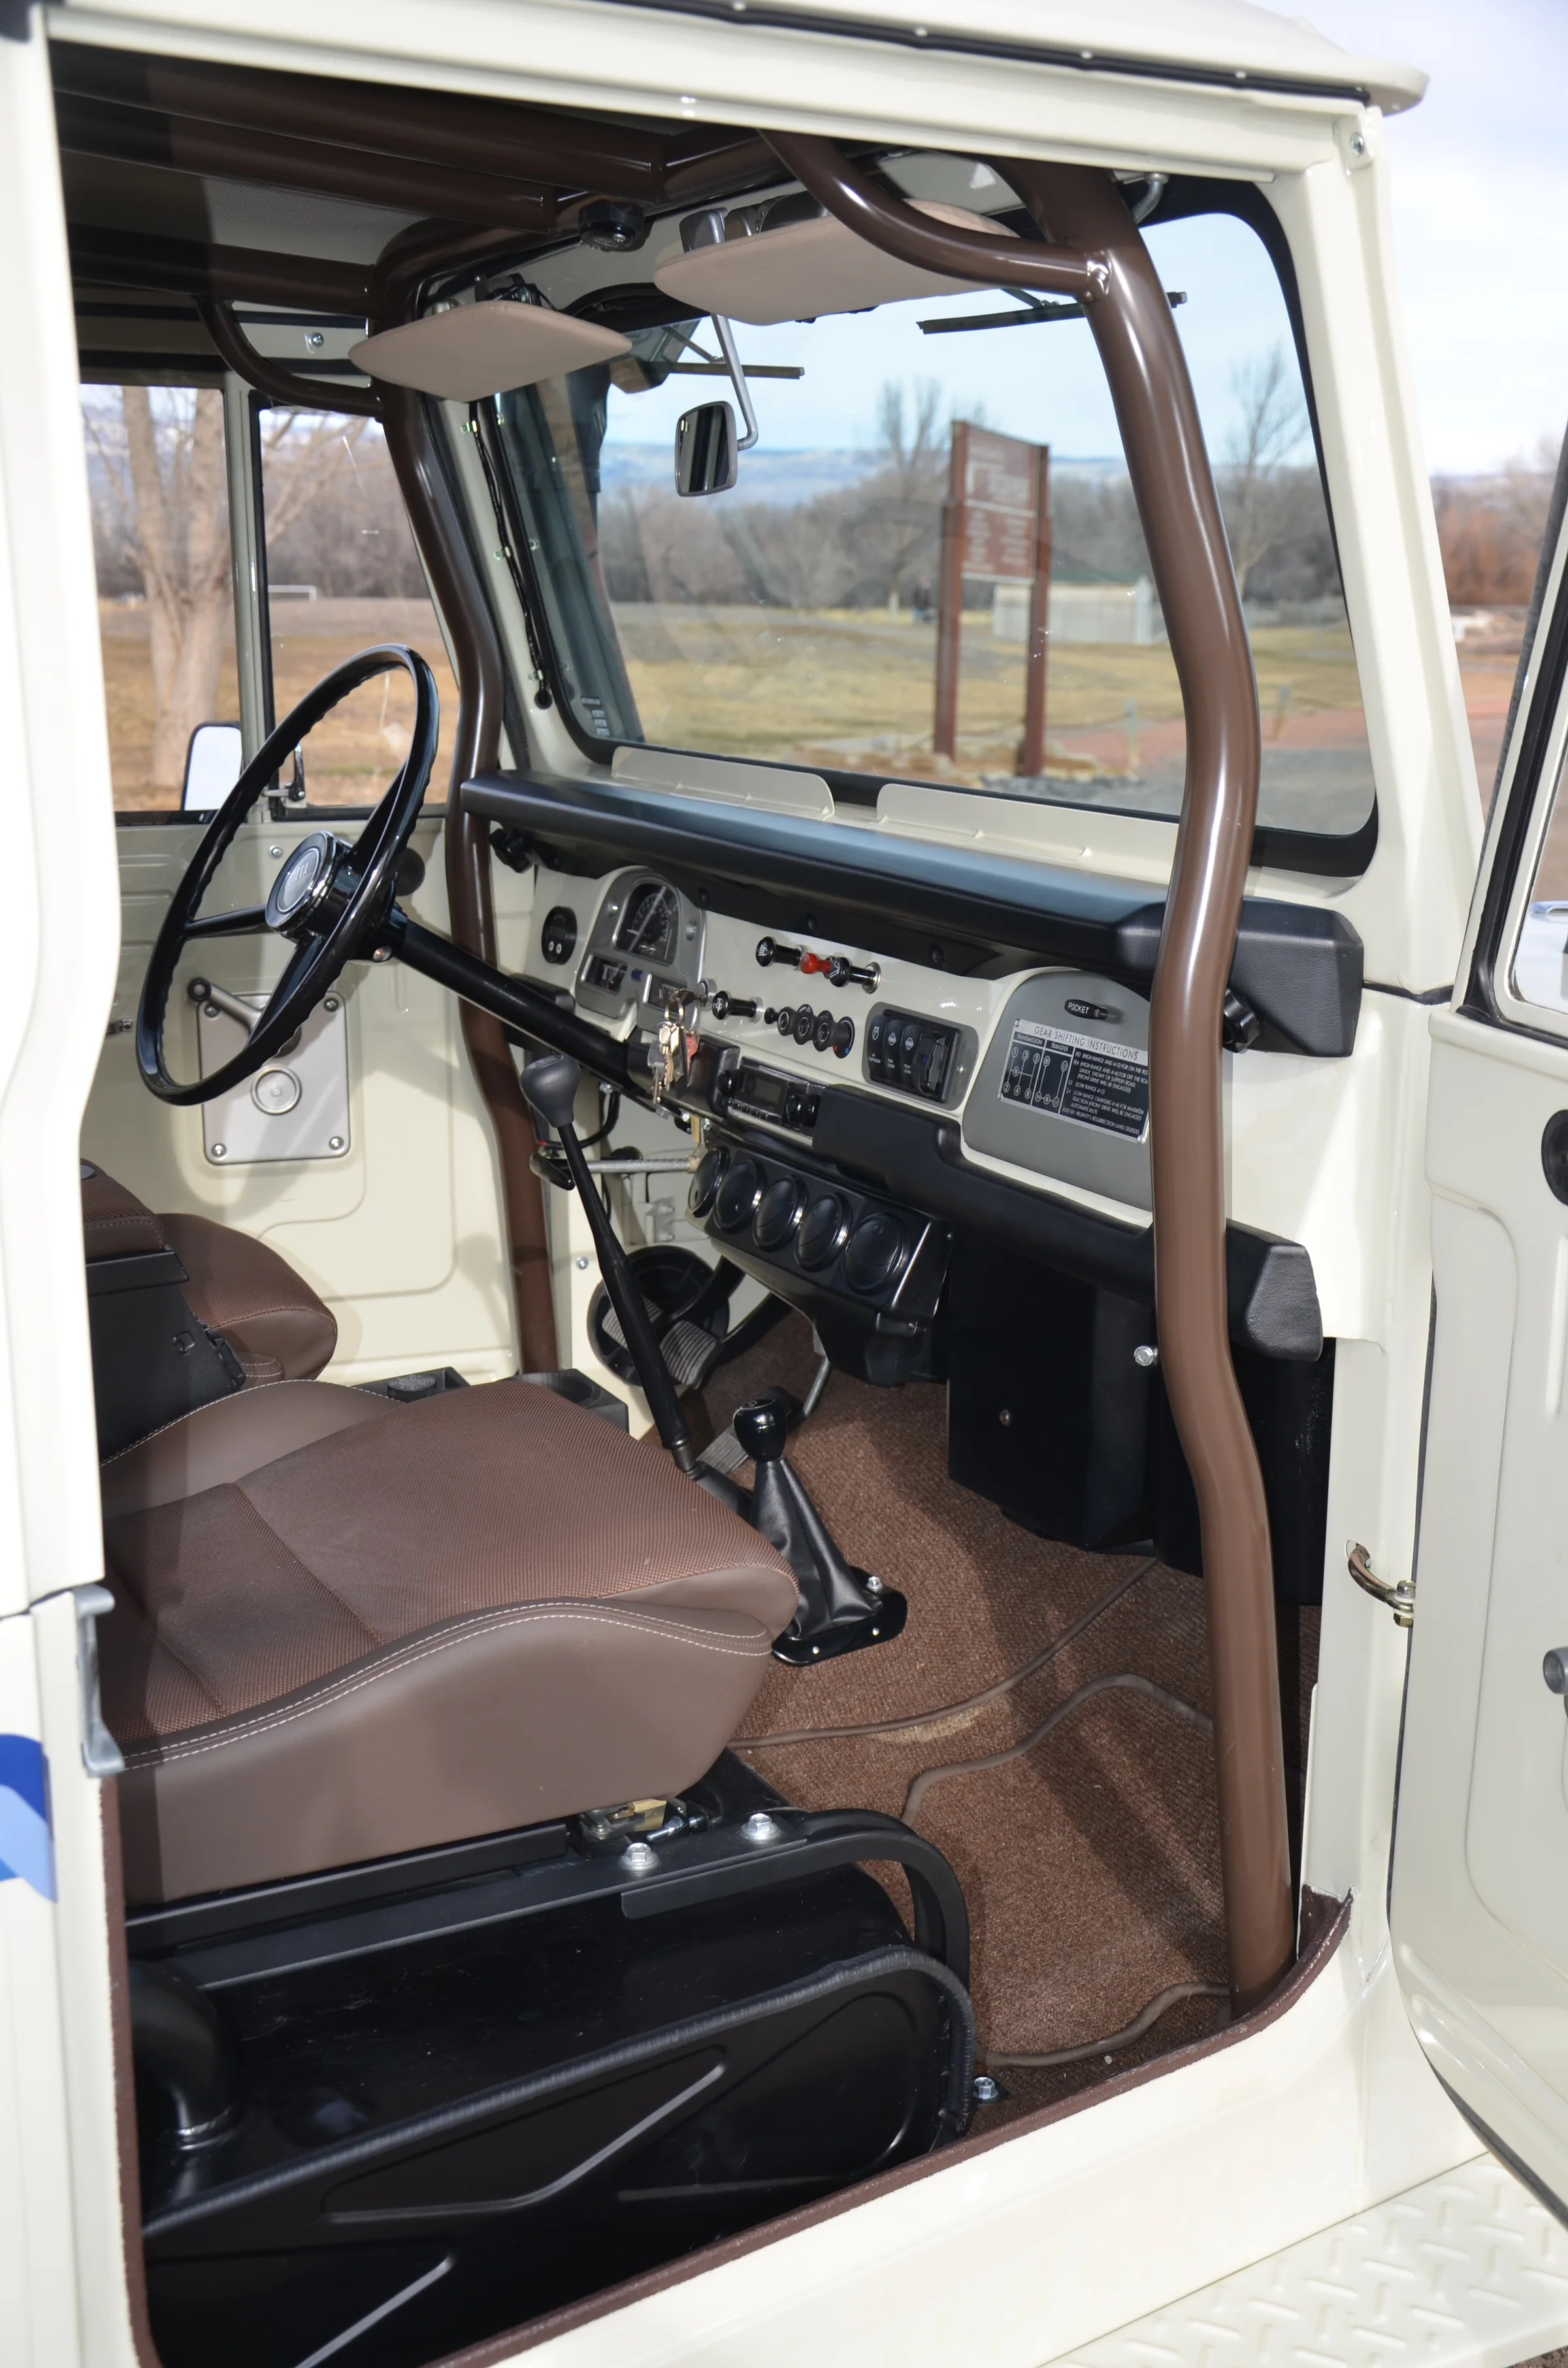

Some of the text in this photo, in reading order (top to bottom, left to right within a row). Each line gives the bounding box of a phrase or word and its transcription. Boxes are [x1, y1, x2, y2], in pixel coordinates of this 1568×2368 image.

[1068, 1002, 1089, 1015] POCKET
[1017, 1033, 1042, 1044] TRANSMISSION
[1034, 1027, 1138, 1061] GEAR SHIFTING INSTRUCTIONS
[1051, 1042, 1068, 1051] TRANSFER
[1090, 1063, 1102, 1072] RANGE
[1091, 1070, 1104, 1079] SNOWY
[1111, 1076, 1124, 1084] SLIPPERY
[1082, 1092, 1094, 1100] RANGE
[1094, 1096, 1111, 1106] CRAWLING
[1072, 1096, 1088, 1105] TRACTION
[1124, 1111, 1141, 1121] ENGAGED
[1092, 1115, 1115, 1127] RESURRECTION
[1124, 1125, 1139, 1134] CRUISERS
